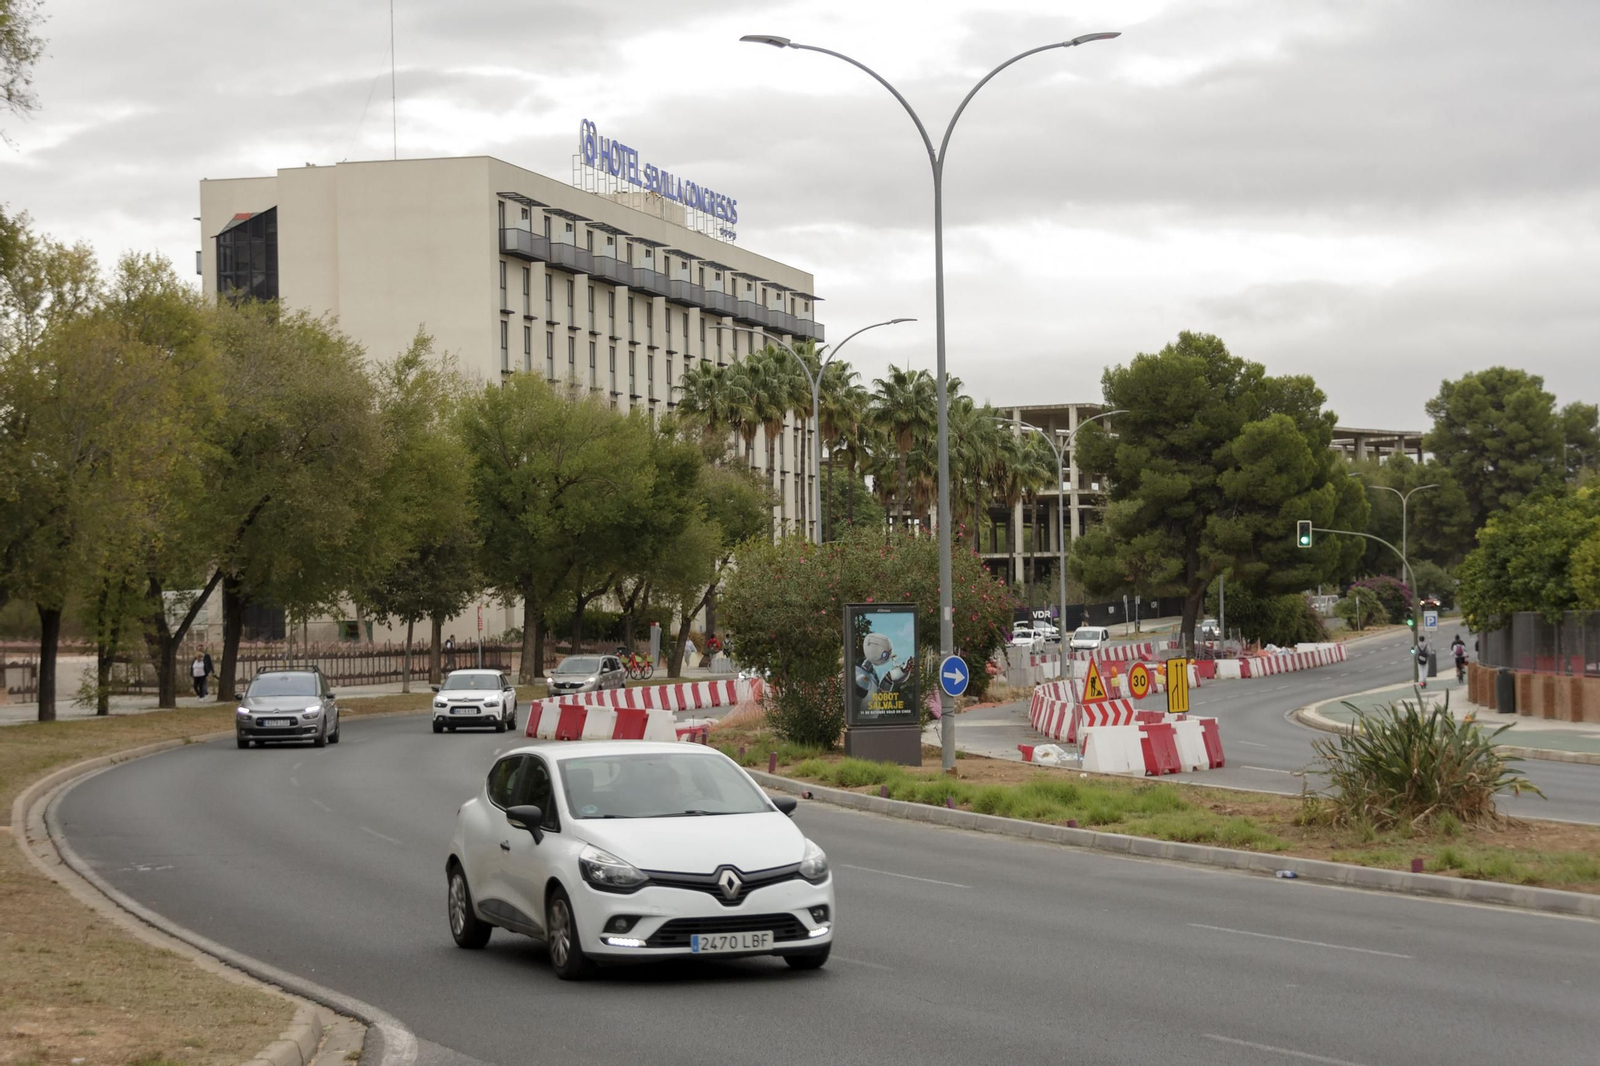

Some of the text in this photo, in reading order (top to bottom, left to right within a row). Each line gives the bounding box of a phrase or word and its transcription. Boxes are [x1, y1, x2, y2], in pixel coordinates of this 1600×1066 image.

[598, 136, 738, 224] HOTEL SEVILLA CONGRESOS
[1427, 617, 1434, 626] P
[1133, 674, 1146, 687] 30
[872, 692, 899, 701] ROBOT
[868, 700, 904, 710] SALVAJE
[700, 933, 769, 951] 2470 LBF
